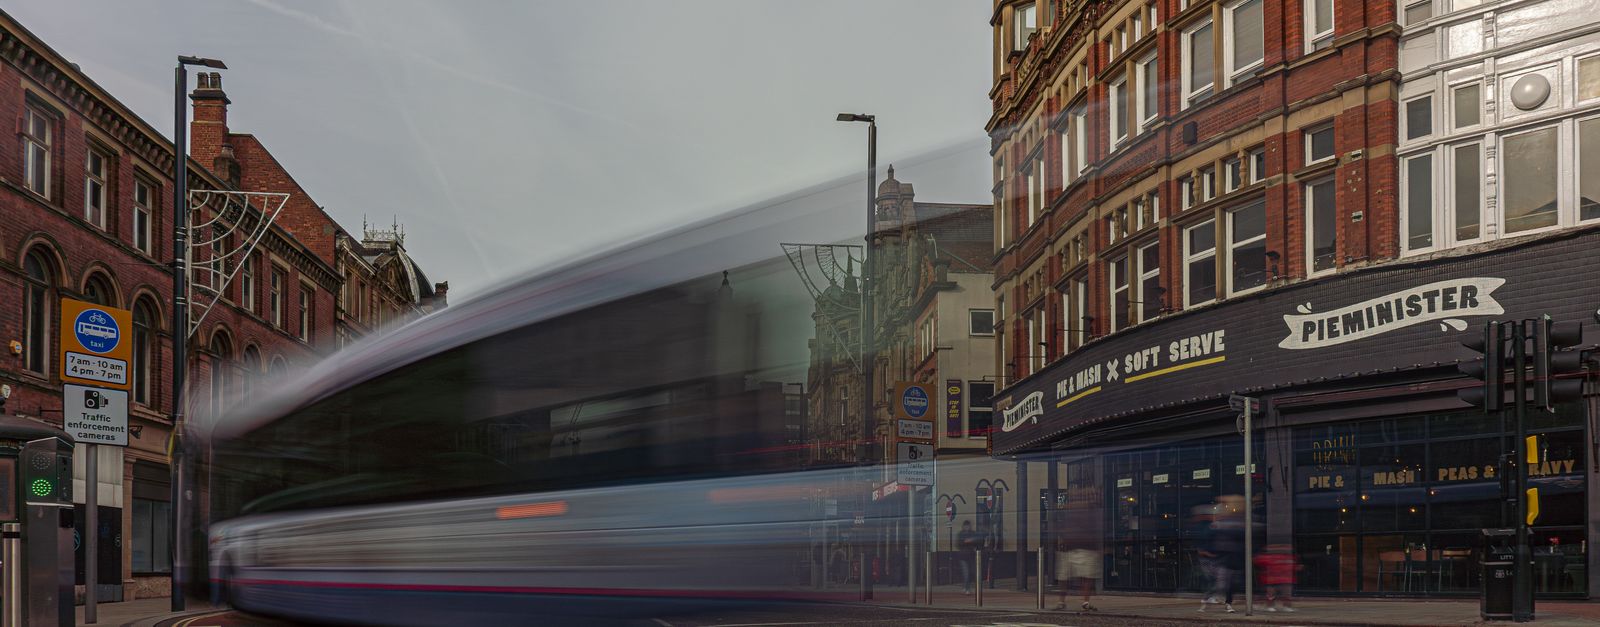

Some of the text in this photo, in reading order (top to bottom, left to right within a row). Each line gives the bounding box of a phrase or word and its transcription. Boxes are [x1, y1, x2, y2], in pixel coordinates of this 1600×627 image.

[1301, 284, 1479, 342] PIEMINISTER
[90, 340, 104, 348] taxi
[77, 358, 90, 366] am
[98, 360, 108, 369] 10
[110, 363, 123, 371] am
[1057, 379, 1068, 400] PIE
[1069, 376, 1074, 394] &
[1076, 364, 1101, 391] MASH
[1124, 345, 1160, 374] SOFT
[1169, 329, 1225, 362] SERVE
[72, 365, 78, 373] 4
[80, 368, 94, 377] pm
[108, 371, 121, 380] pm
[81, 412, 111, 422] Traffic
[1006, 395, 1039, 428] PIEMINISTER
[68, 421, 125, 433] enforcement
[78, 431, 116, 441] cameras
[1309, 458, 1575, 489] PIE & MASH PEAS & RAVY
